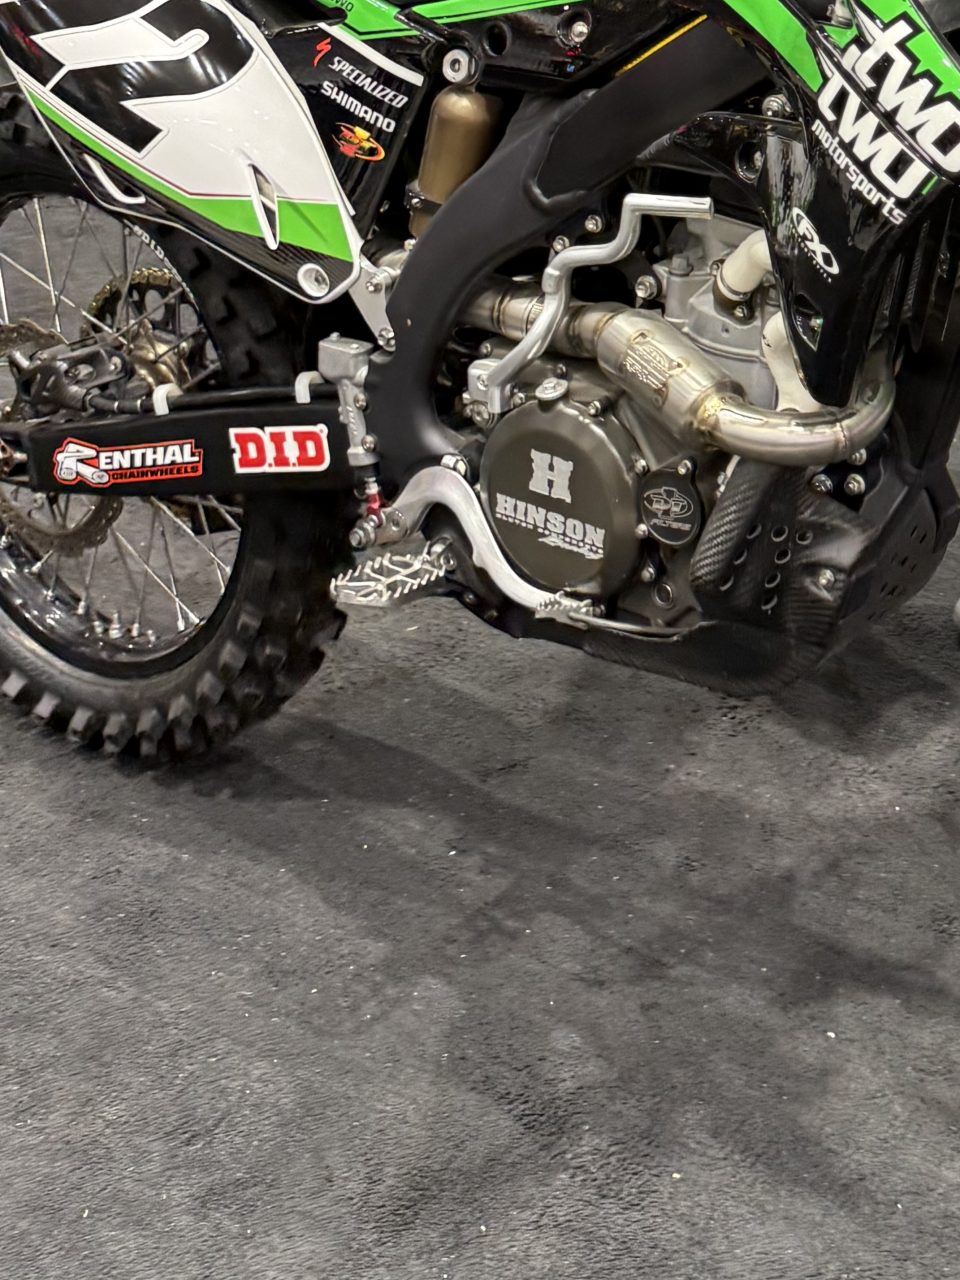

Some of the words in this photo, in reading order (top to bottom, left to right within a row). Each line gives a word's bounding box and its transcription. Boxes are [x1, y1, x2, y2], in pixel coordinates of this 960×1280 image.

[321, 80, 396, 133] SHIMANO
[328, 56, 409, 109] SPECIALIZED
[811, 119, 907, 225] motorsports
[55, 442, 201, 482] RENTHAL
[111, 464, 200, 481] CHAINWHEELS
[529, 448, 574, 504] H
[496, 492, 606, 549] HINSON
